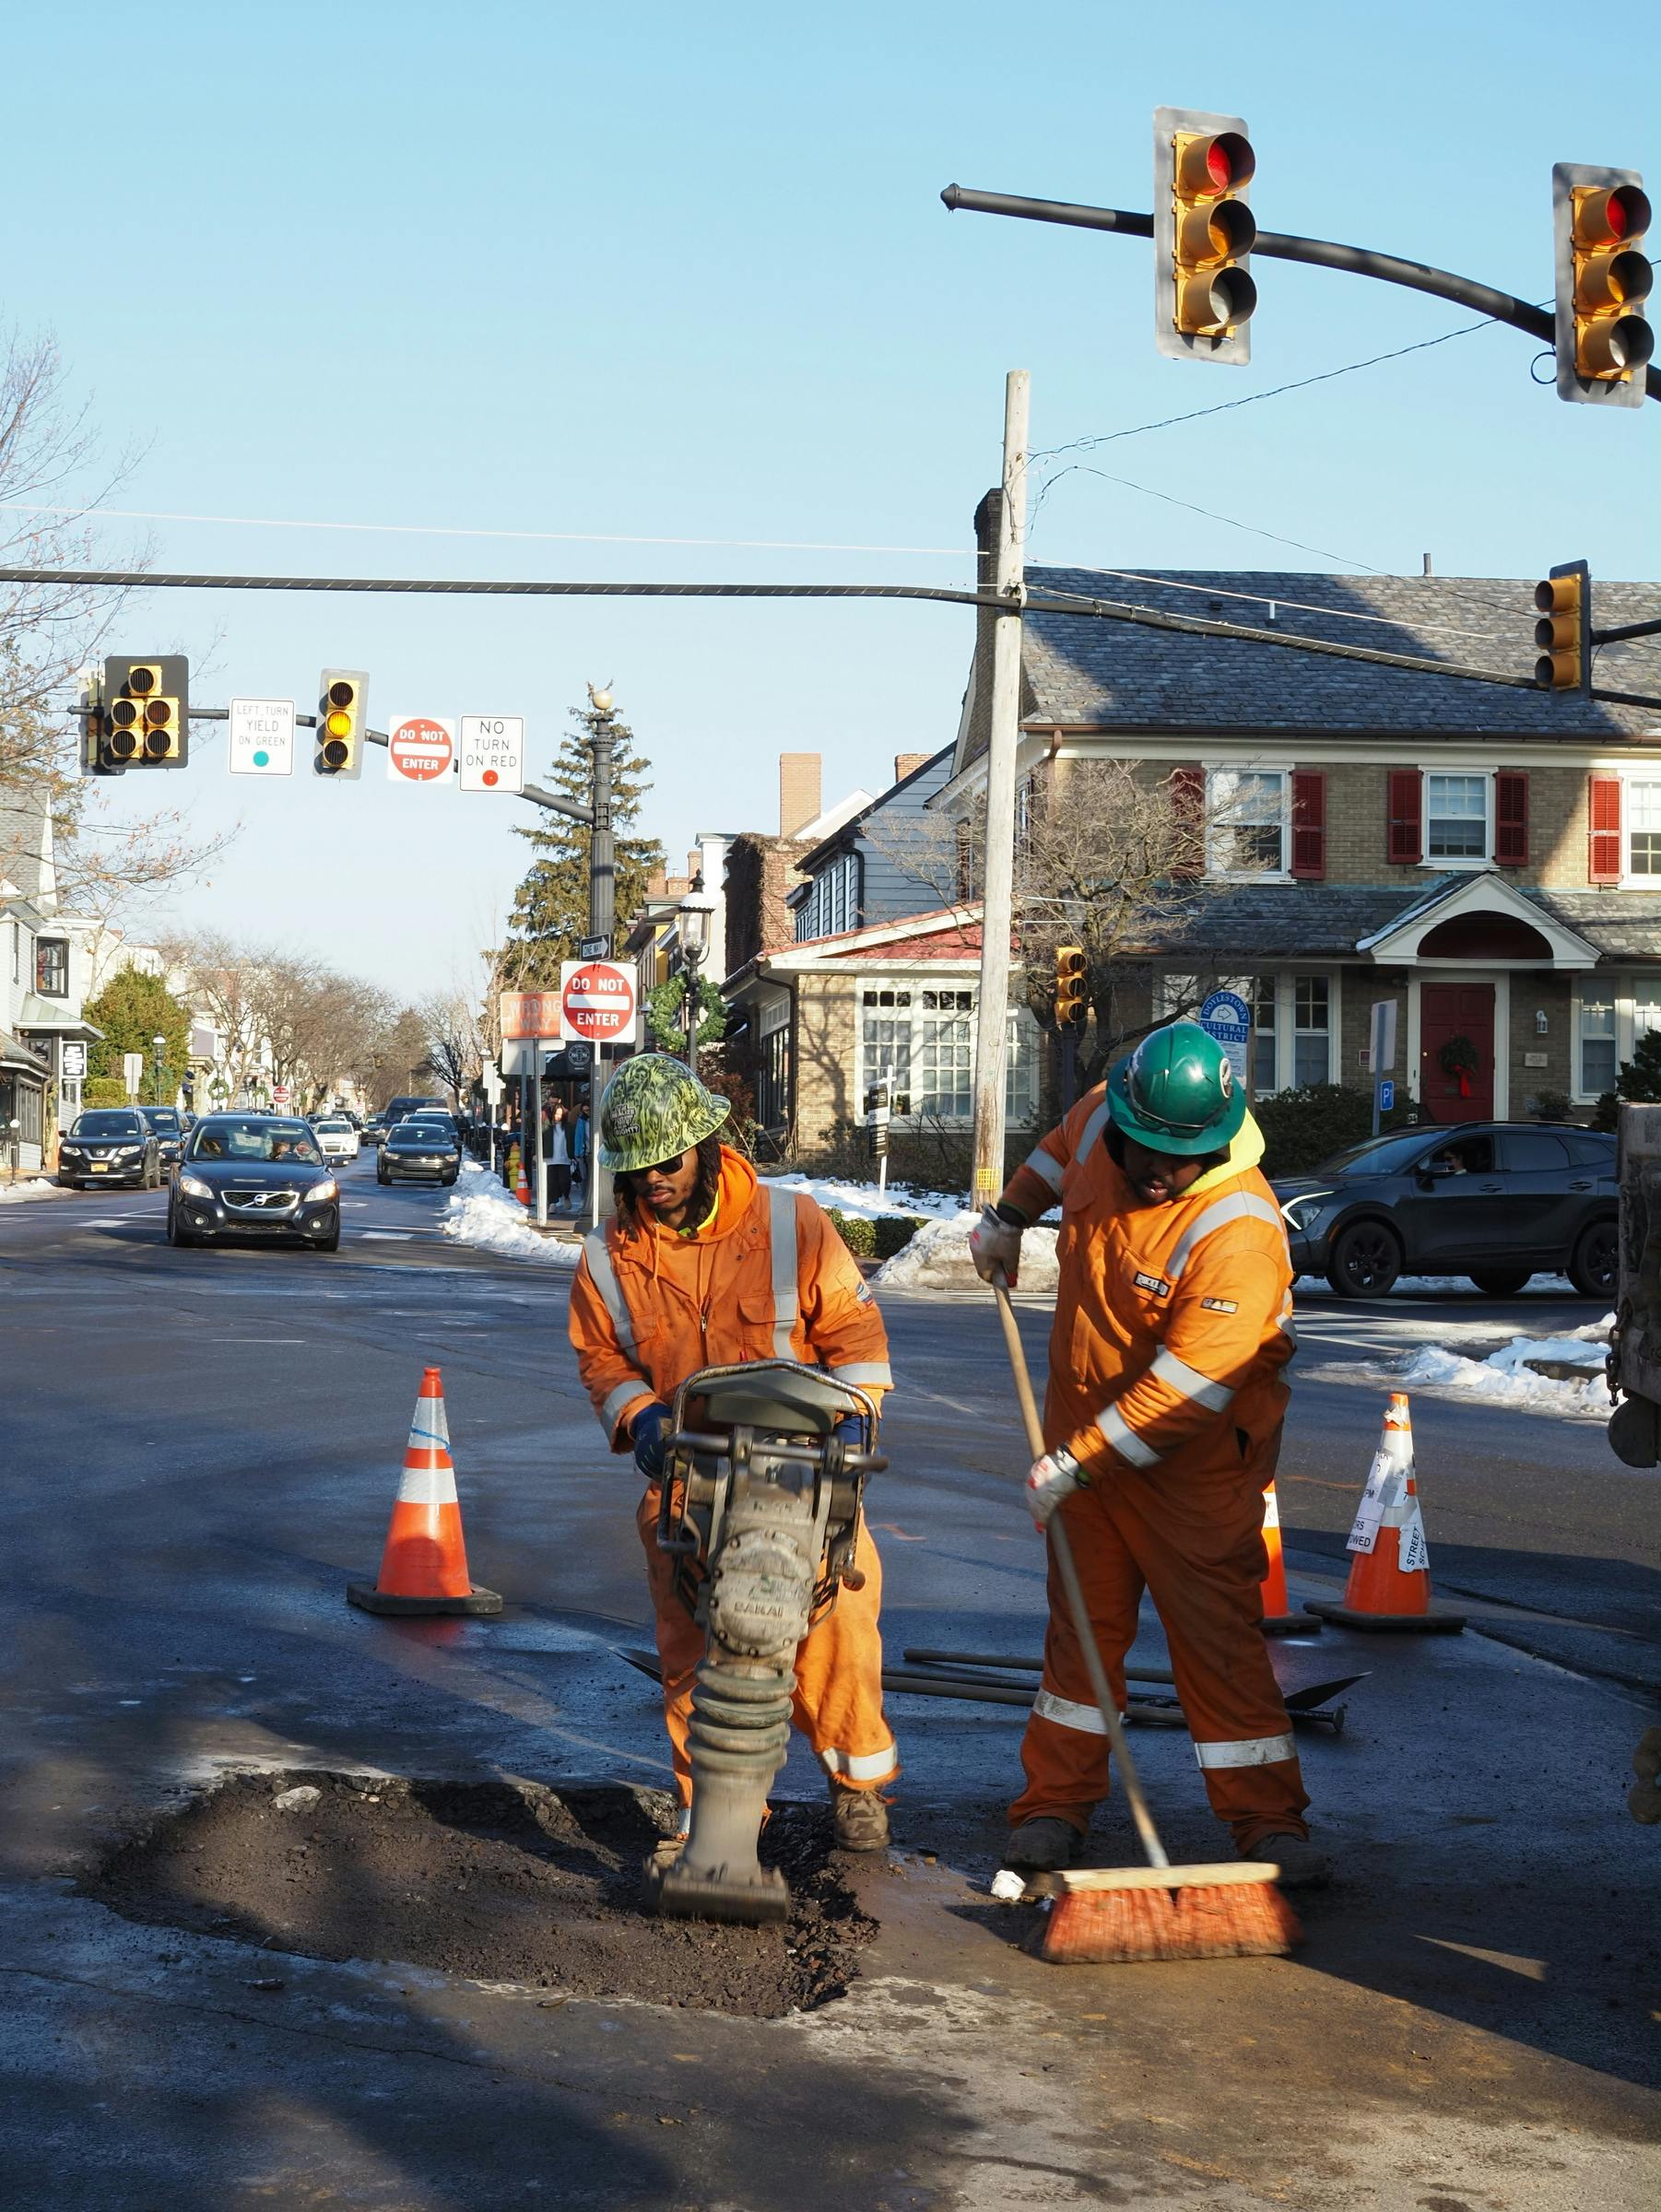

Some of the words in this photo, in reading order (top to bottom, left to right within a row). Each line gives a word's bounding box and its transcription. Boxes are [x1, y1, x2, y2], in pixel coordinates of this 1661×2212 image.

[237, 705, 259, 715] LEFT
[265, 706, 289, 716] TURN
[247, 720, 279, 732] YIELD
[480, 721, 504, 735] NO
[239, 735, 251, 745] ON
[256, 735, 286, 747] GREEN
[399, 728, 416, 740] DO
[421, 730, 444, 742] NOT
[475, 738, 510, 750] TURN
[402, 758, 439, 771] ENTER
[465, 755, 484, 766] ON
[490, 756, 517, 768] RED
[583, 945, 593, 956] ONE
[571, 977, 591, 991] DO
[598, 979, 625, 992] NOT
[509, 1000, 561, 1014] WRONG
[1203, 994, 1247, 1020] DOYLESTOWN
[520, 1018, 551, 1031] WAY
[577, 1012, 619, 1027] ENTER
[1200, 1021, 1247, 1034] CULTURAL
[1207, 1030, 1247, 1042] STRICT
[1384, 1088, 1390, 1103] P
[1406, 1526, 1420, 1566] STREET
